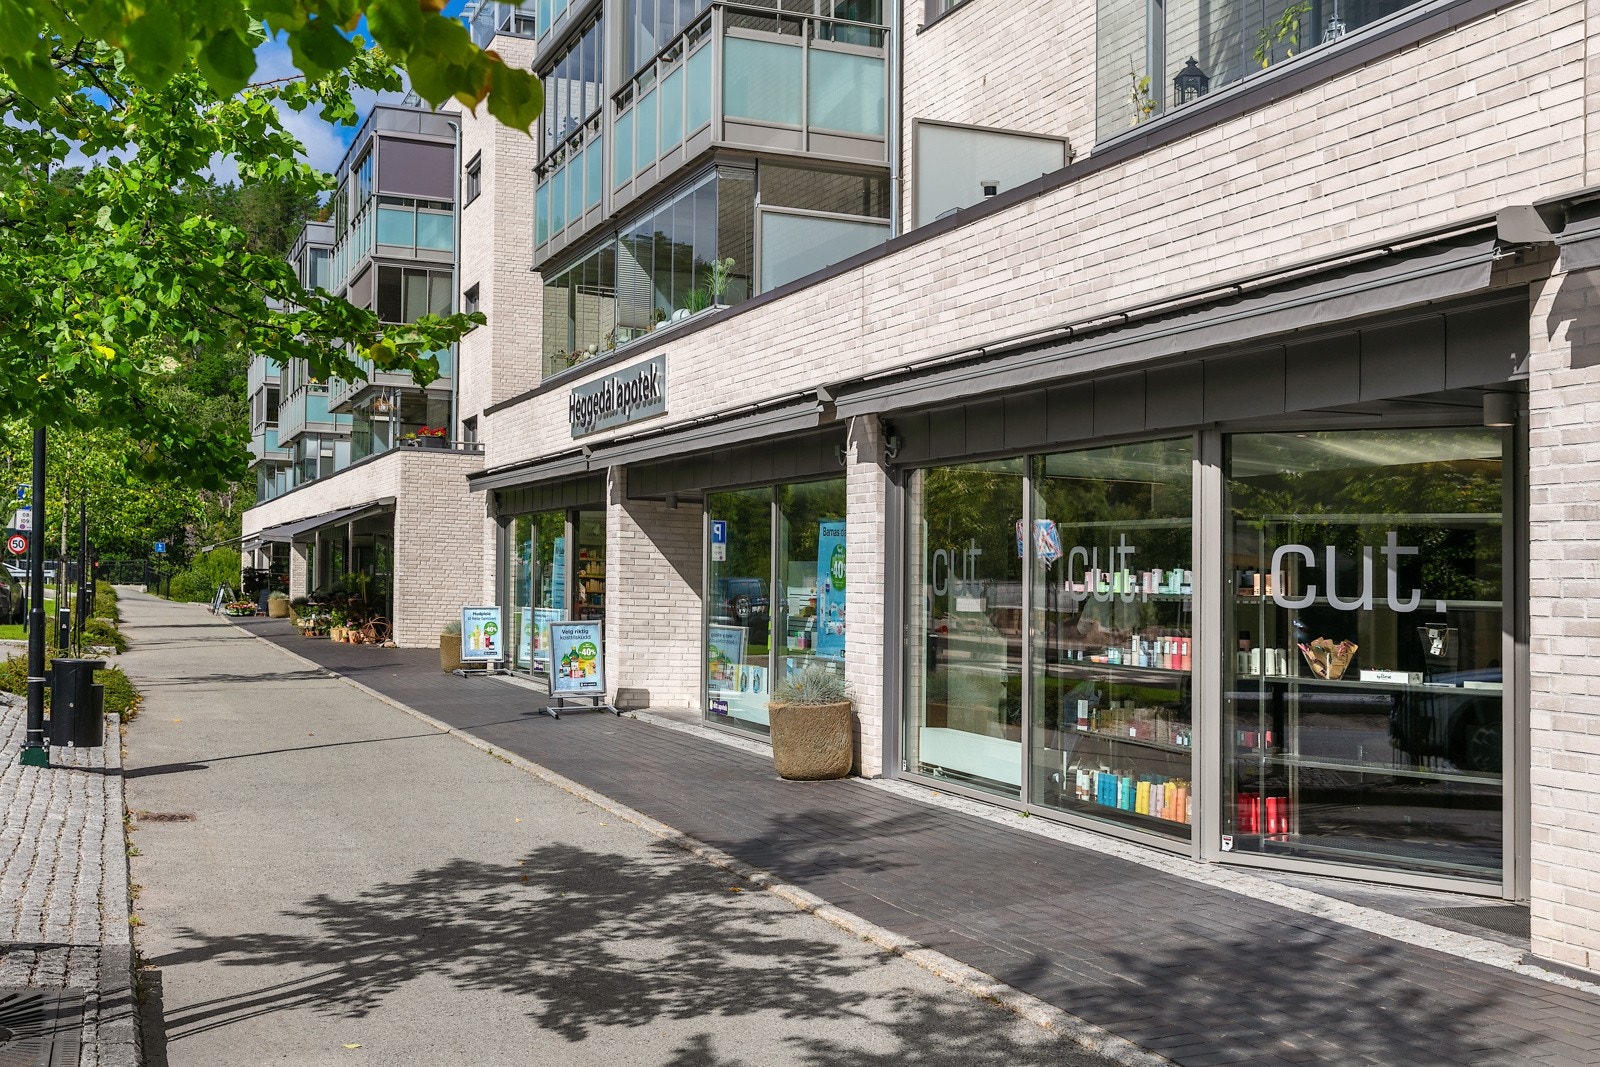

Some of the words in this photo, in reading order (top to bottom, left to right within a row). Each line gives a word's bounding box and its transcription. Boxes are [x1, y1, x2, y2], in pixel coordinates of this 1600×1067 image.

[569, 377, 616, 428] Heggedal
[616, 362, 659, 415] apotek
[822, 526, 840, 537] Barnas
[12, 539, 24, 549] 50
[1270, 531, 1447, 613] cut.
[579, 648, 596, 656] -40%
